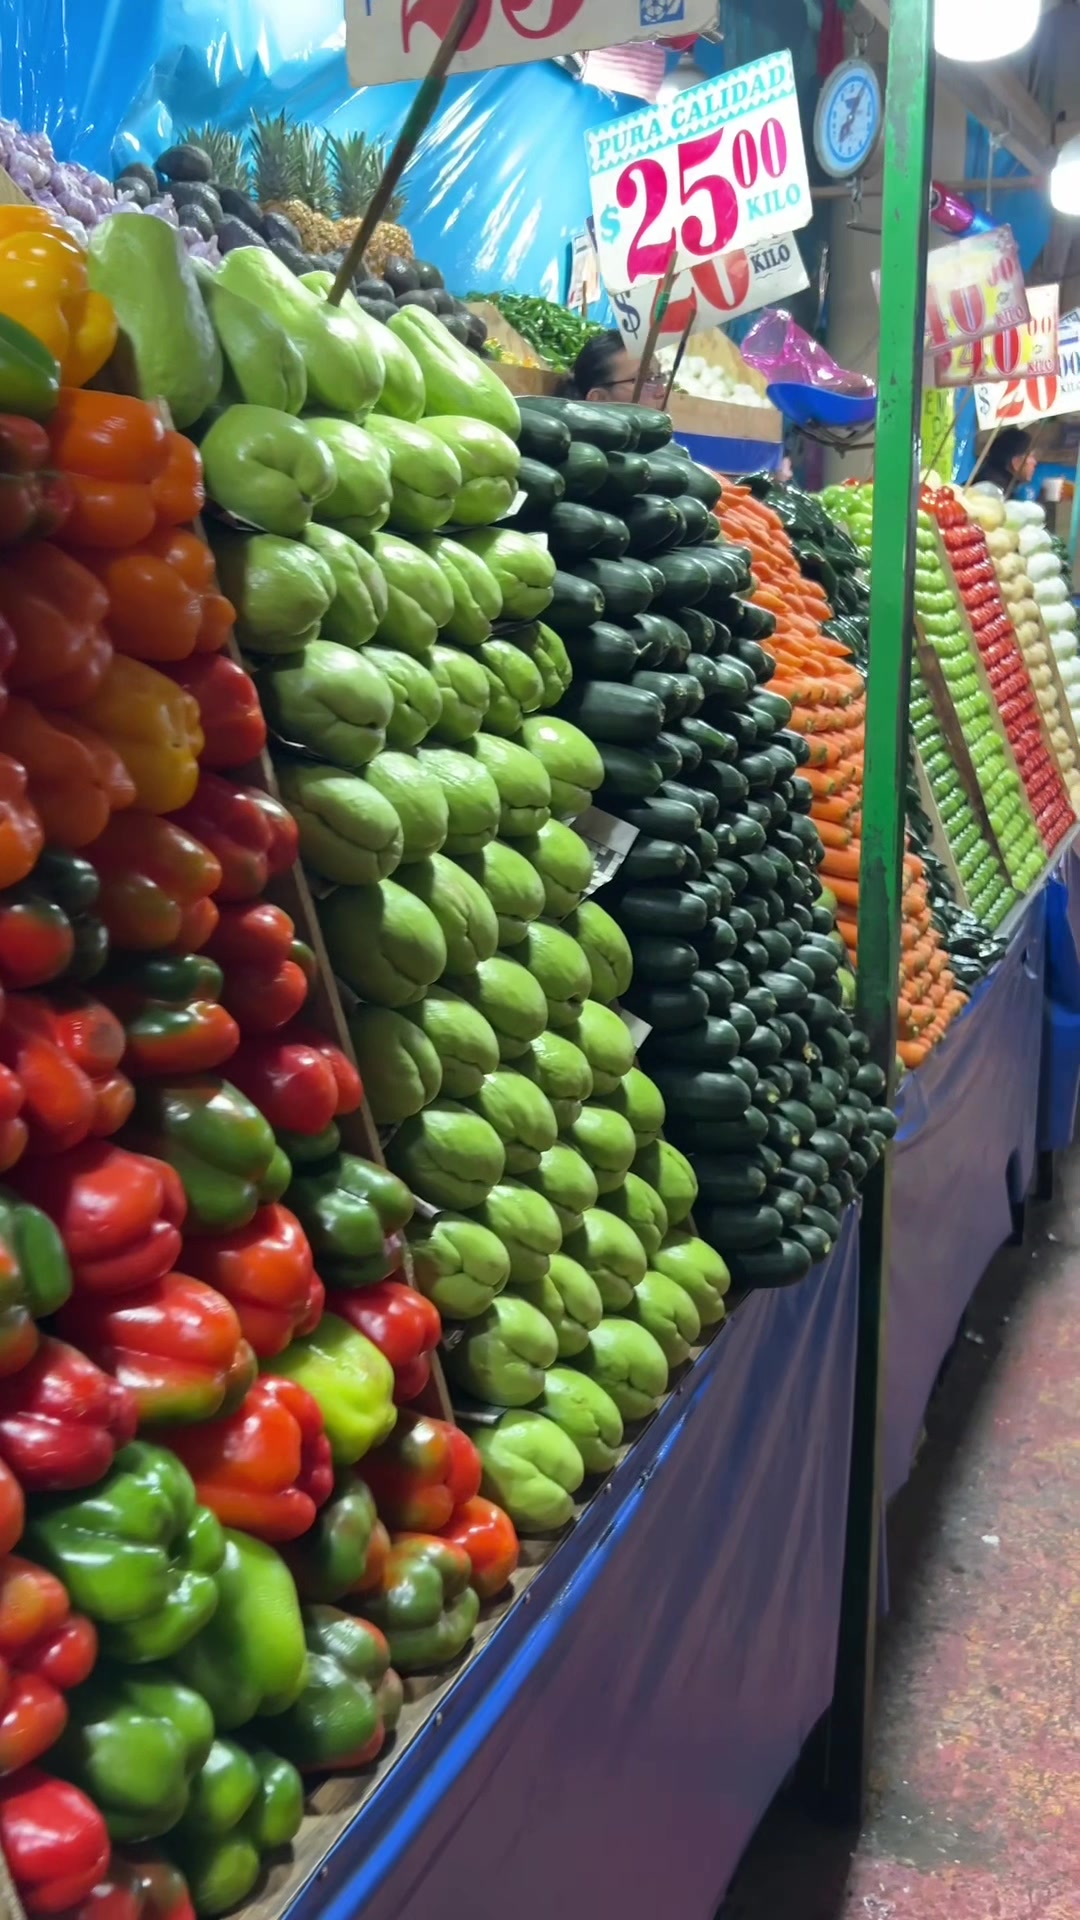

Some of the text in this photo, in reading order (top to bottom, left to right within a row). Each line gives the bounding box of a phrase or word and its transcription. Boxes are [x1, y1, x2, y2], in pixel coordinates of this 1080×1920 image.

[598, 119, 666, 160] PURA
[671, 65, 785, 129] CALIDAD
[746, 184, 801, 221] KILO
[600, 204, 621, 245] $
[750, 245, 790, 274] KILO
